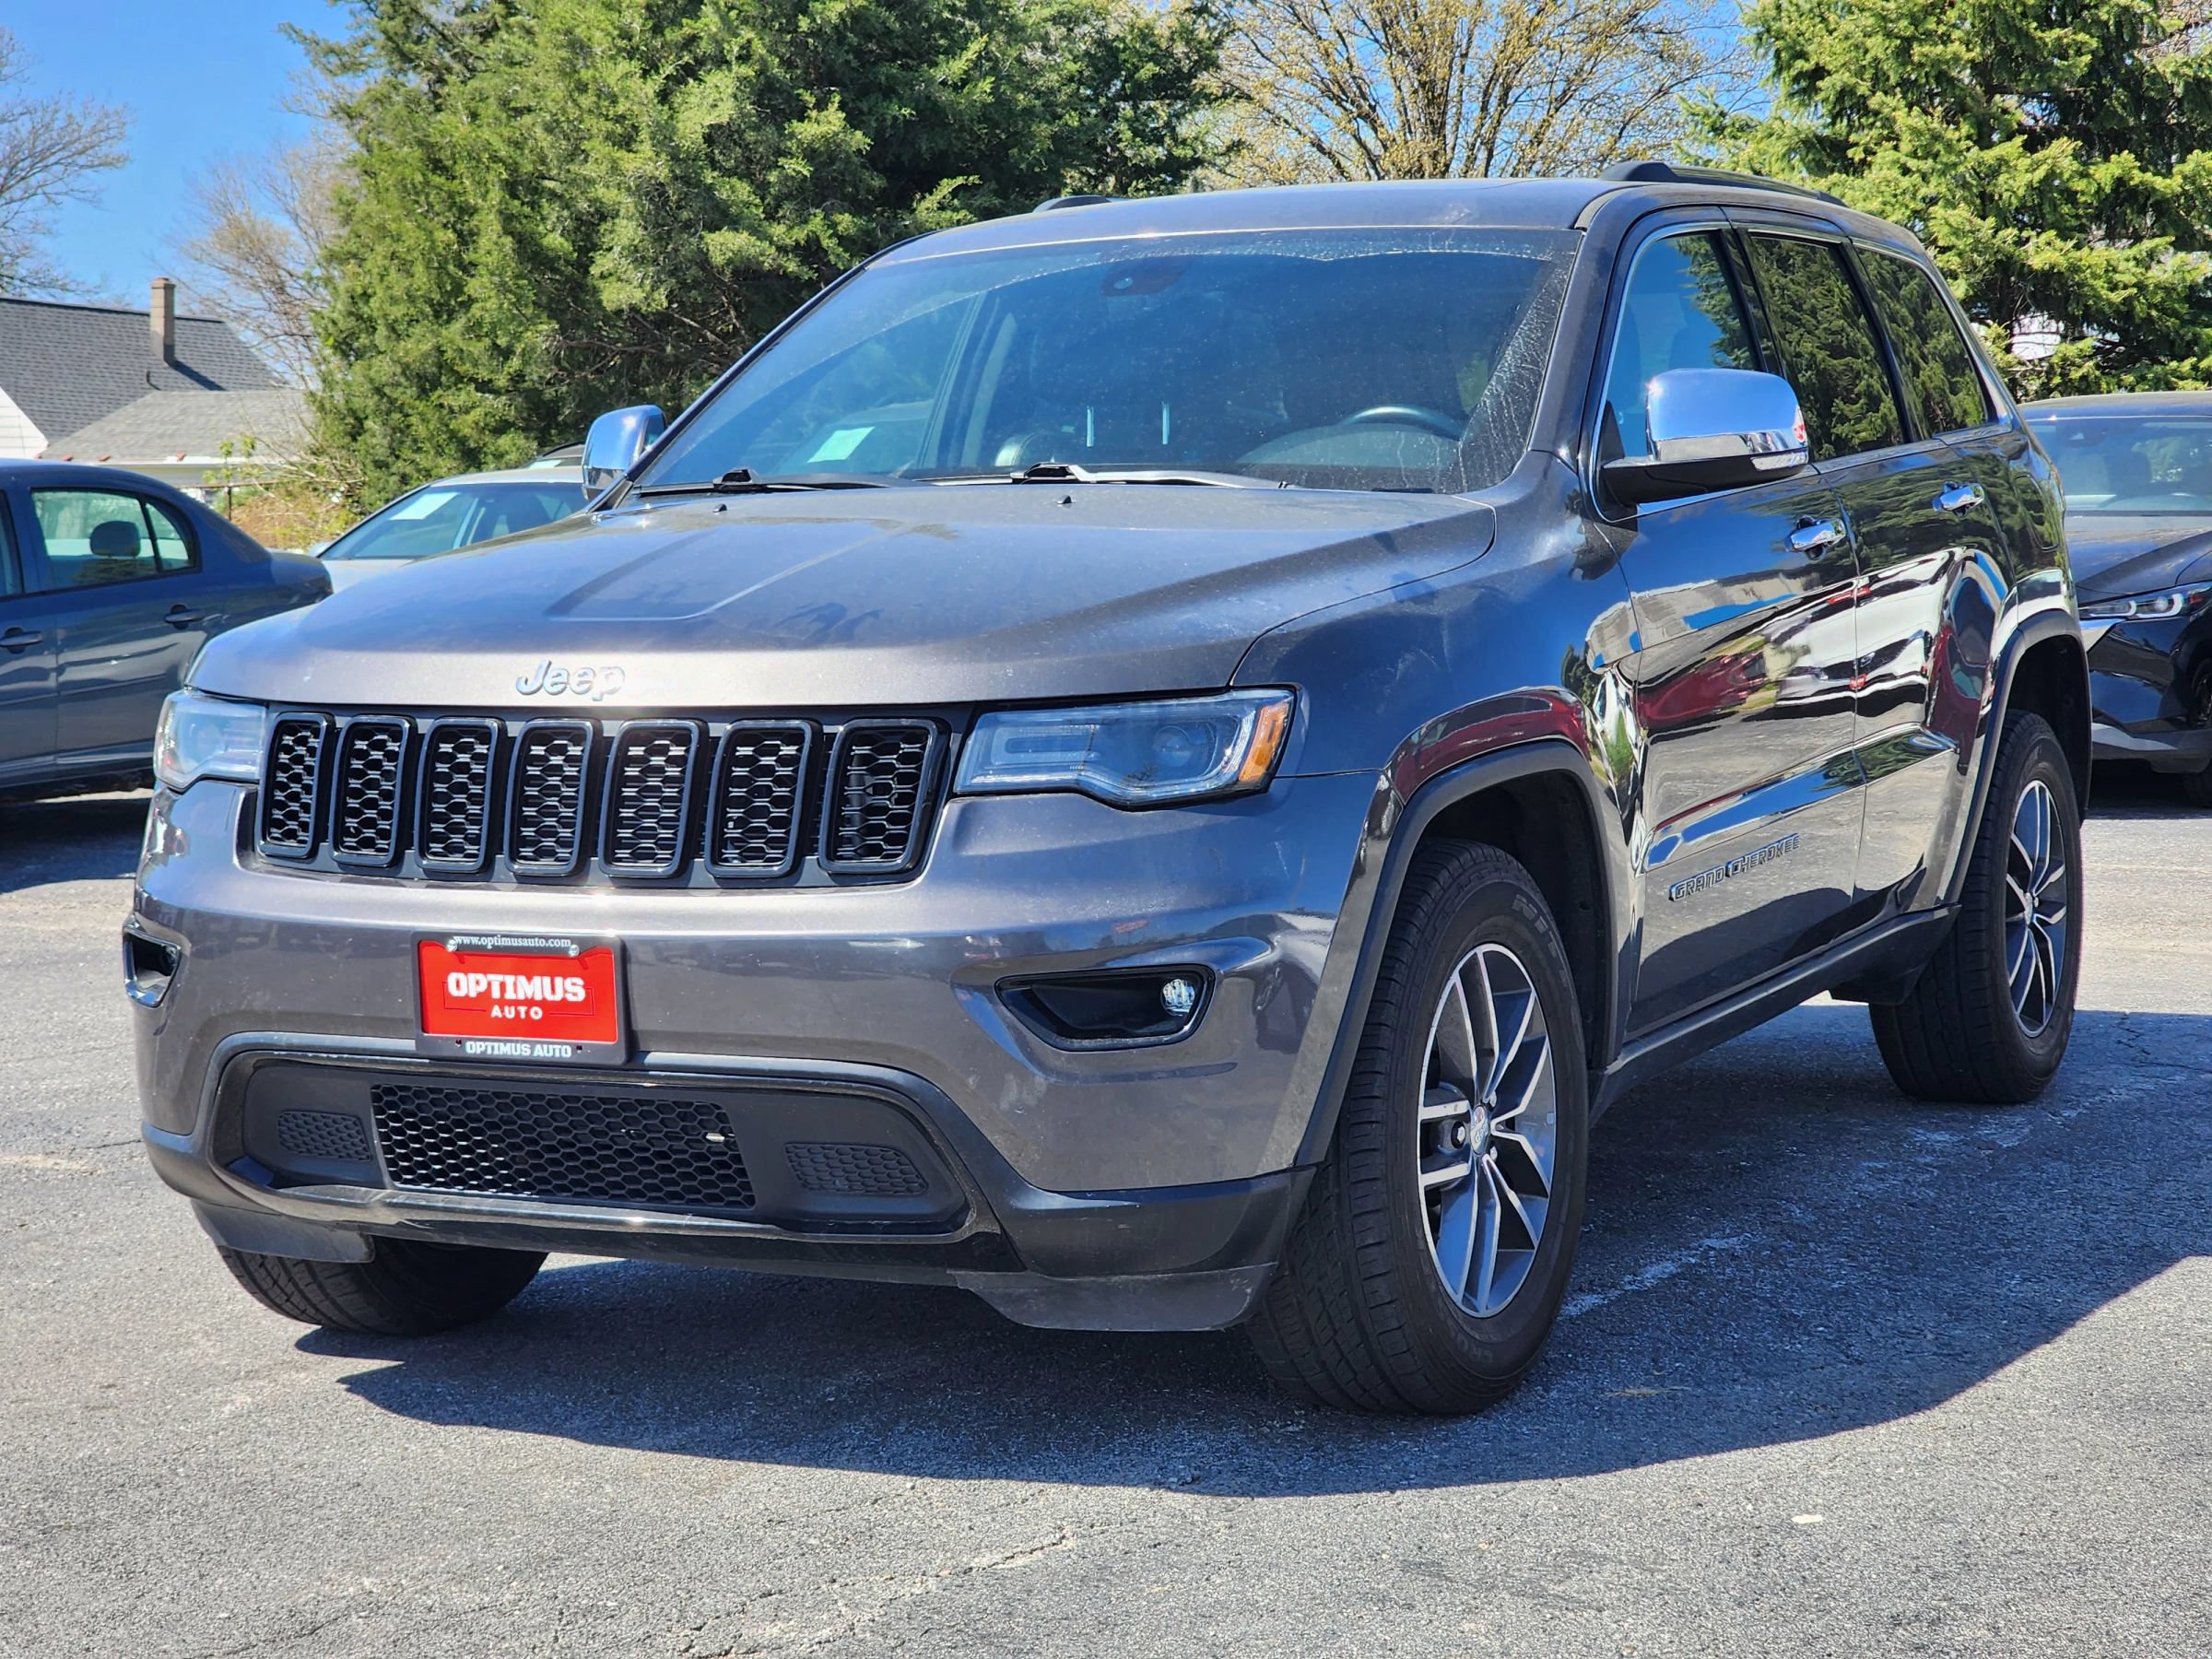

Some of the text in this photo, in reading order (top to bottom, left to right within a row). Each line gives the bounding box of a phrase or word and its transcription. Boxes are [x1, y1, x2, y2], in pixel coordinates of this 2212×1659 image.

[516, 659, 625, 701] Jeep
[1669, 832, 1801, 901] GRAND CHEROKEE
[453, 935, 571, 949] www.optimusauto.com
[447, 971, 586, 1002] OPTIMUS
[490, 1005, 544, 1020] AUTO
[465, 1041, 572, 1058] OPTIMUS AUTO
